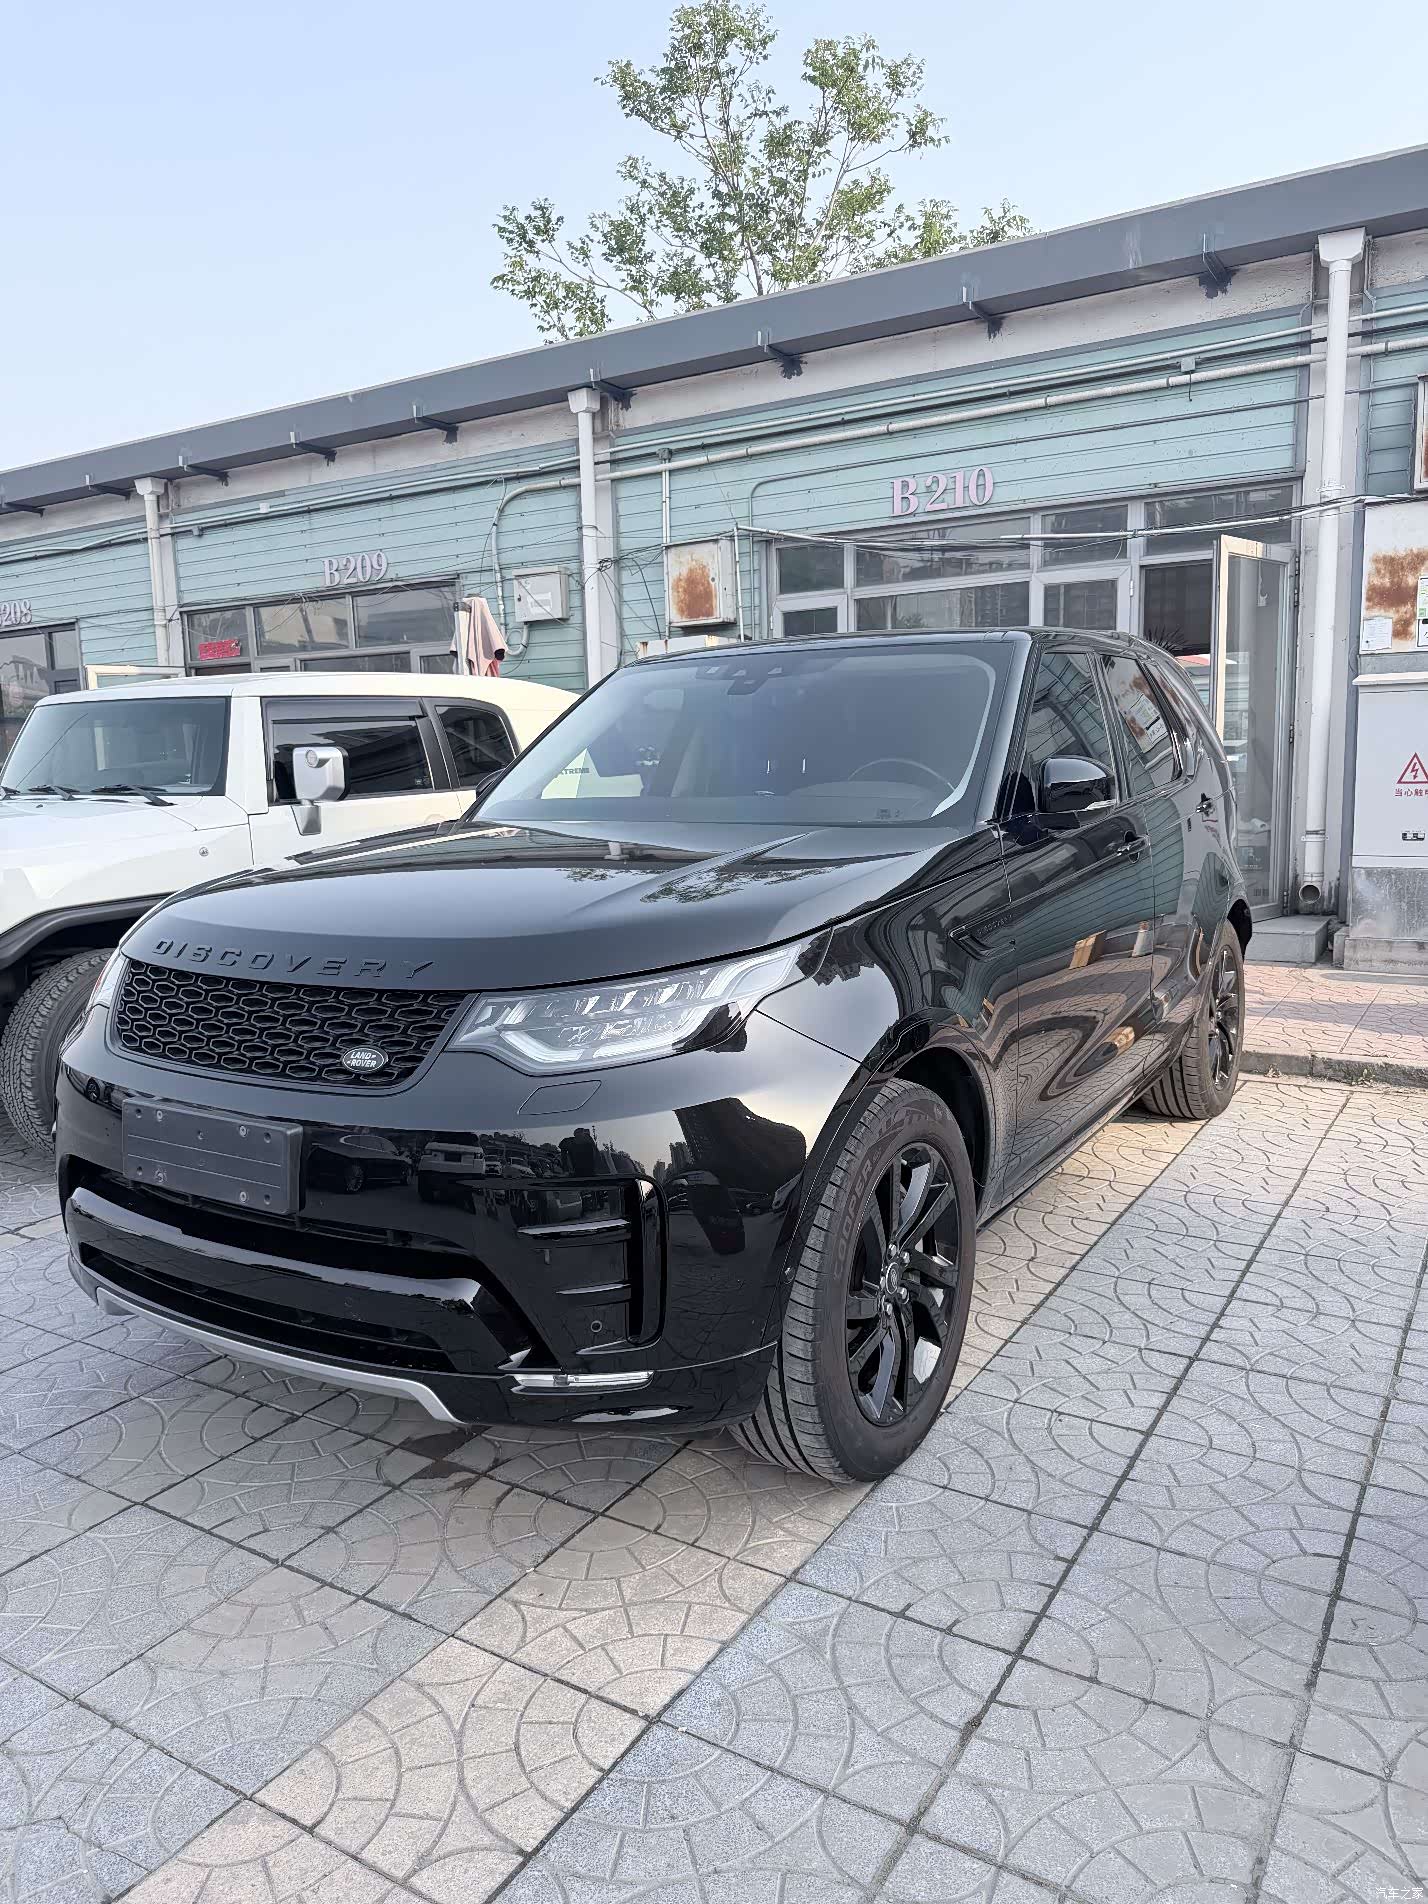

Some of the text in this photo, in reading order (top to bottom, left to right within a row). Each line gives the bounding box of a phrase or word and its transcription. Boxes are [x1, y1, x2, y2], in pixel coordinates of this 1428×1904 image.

[890, 467, 994, 517] B210
[322, 550, 388, 587] B209
[0, 599, 32, 625] 208
[152, 939, 434, 979] DISCOVERY
